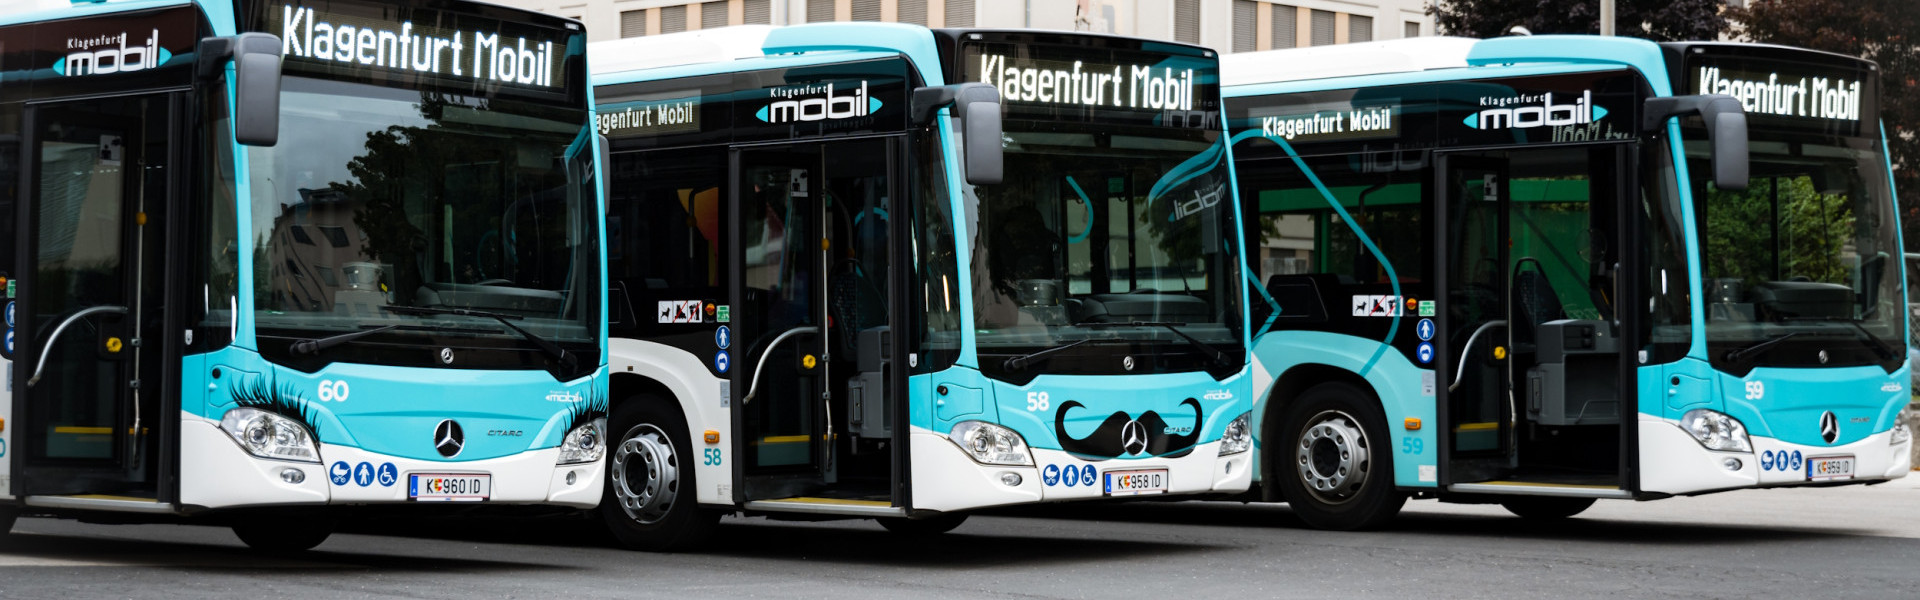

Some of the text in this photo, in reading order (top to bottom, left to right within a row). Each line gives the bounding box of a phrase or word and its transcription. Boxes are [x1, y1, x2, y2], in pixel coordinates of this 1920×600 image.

[65, 28, 159, 77] mobil
[67, 35, 121, 50] Klagenfurt
[284, 5, 552, 87] Klagenfurt Mobil
[770, 85, 827, 99] Klagenfurt
[980, 53, 1193, 111] Klagenfurt Mobil
[770, 80, 868, 123] mobil
[1479, 94, 1544, 107] Klagenfurt
[1811, 76, 1860, 121] Mobil
[657, 101, 693, 125] Mobil
[1479, 89, 1591, 130] mobil
[1262, 108, 1391, 140] Klagenfurt Mobil
[318, 379, 350, 402] 60
[1745, 380, 1764, 400] 59
[1027, 391, 1050, 412] 58
[487, 429, 523, 437] CITARO
[1402, 436, 1423, 455] 59
[704, 447, 722, 466] 58
[426, 478, 434, 494] K
[443, 478, 466, 494] 960
[1131, 474, 1149, 489] 958
